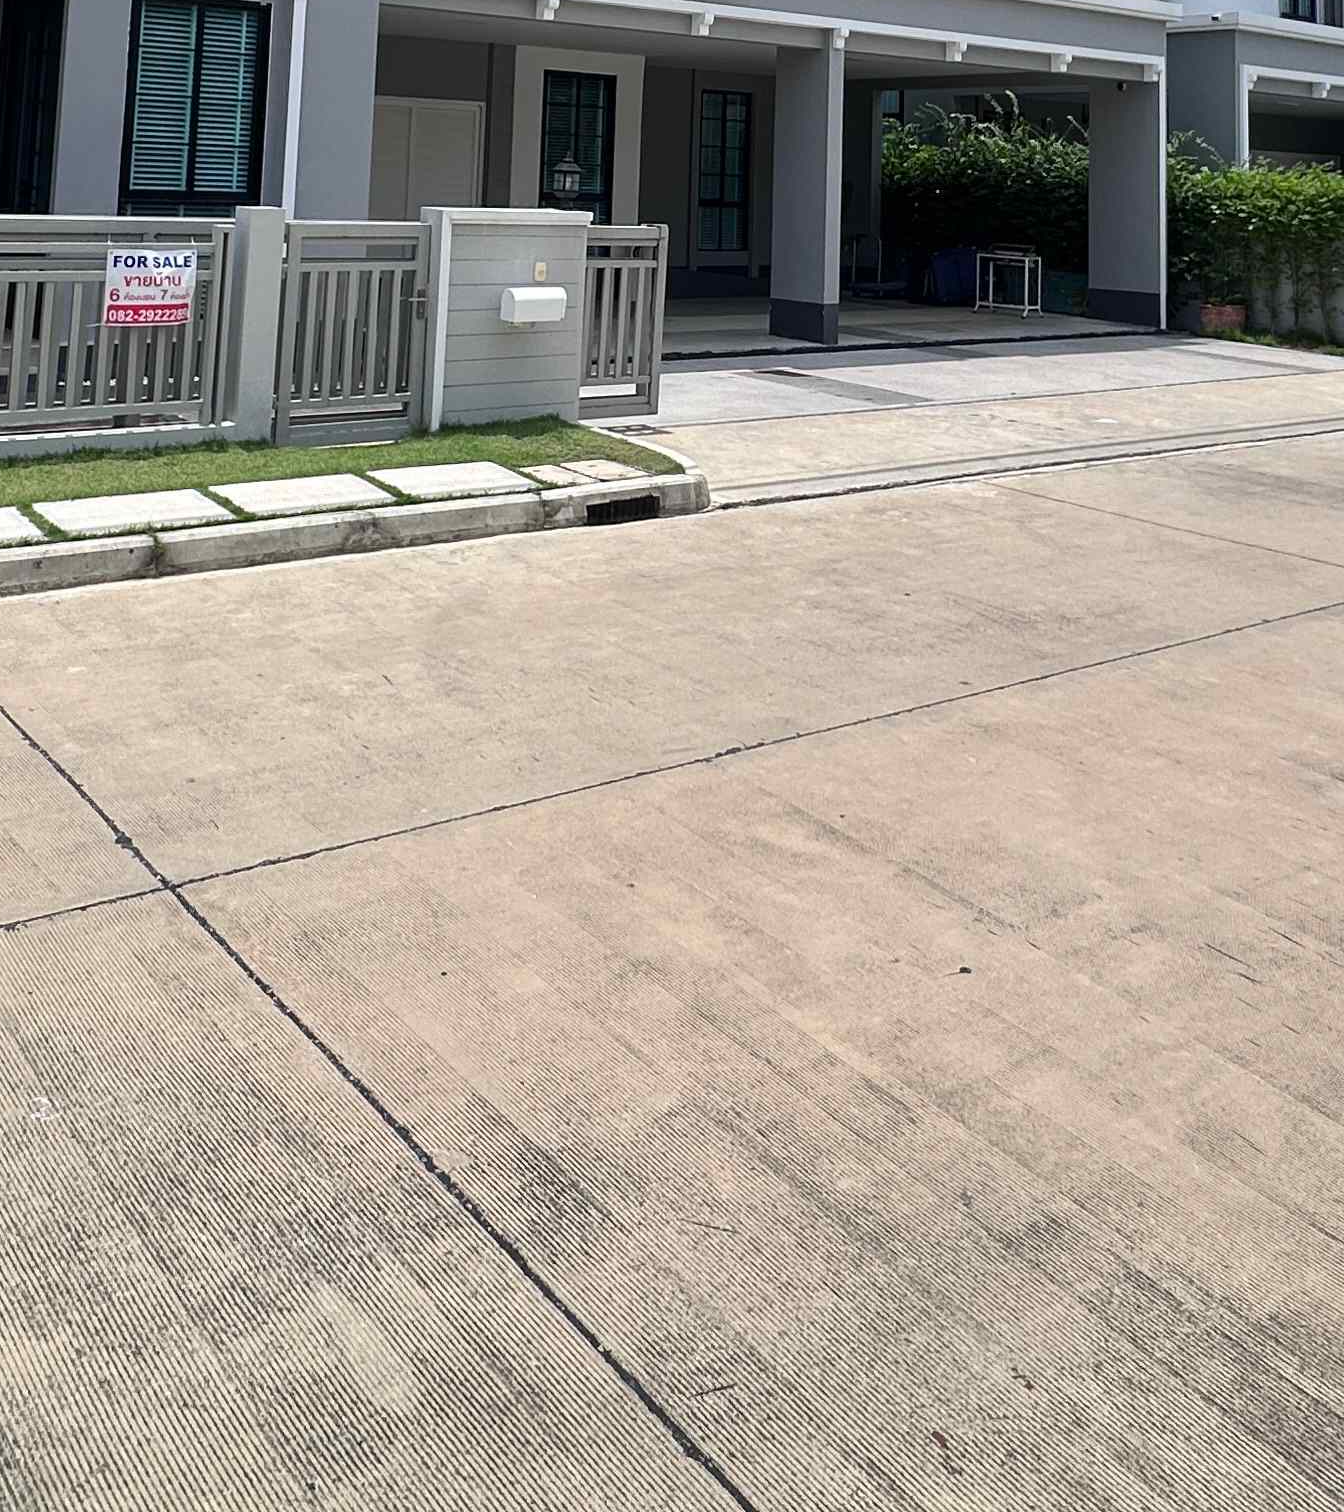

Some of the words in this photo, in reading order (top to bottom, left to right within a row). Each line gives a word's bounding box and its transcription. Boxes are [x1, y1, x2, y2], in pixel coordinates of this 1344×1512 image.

[113, 255, 148, 268] FOR
[153, 255, 192, 269] SALE
[124, 272, 181, 287] ขายบ้าน
[109, 288, 120, 302] 6
[160, 289, 168, 300] 7
